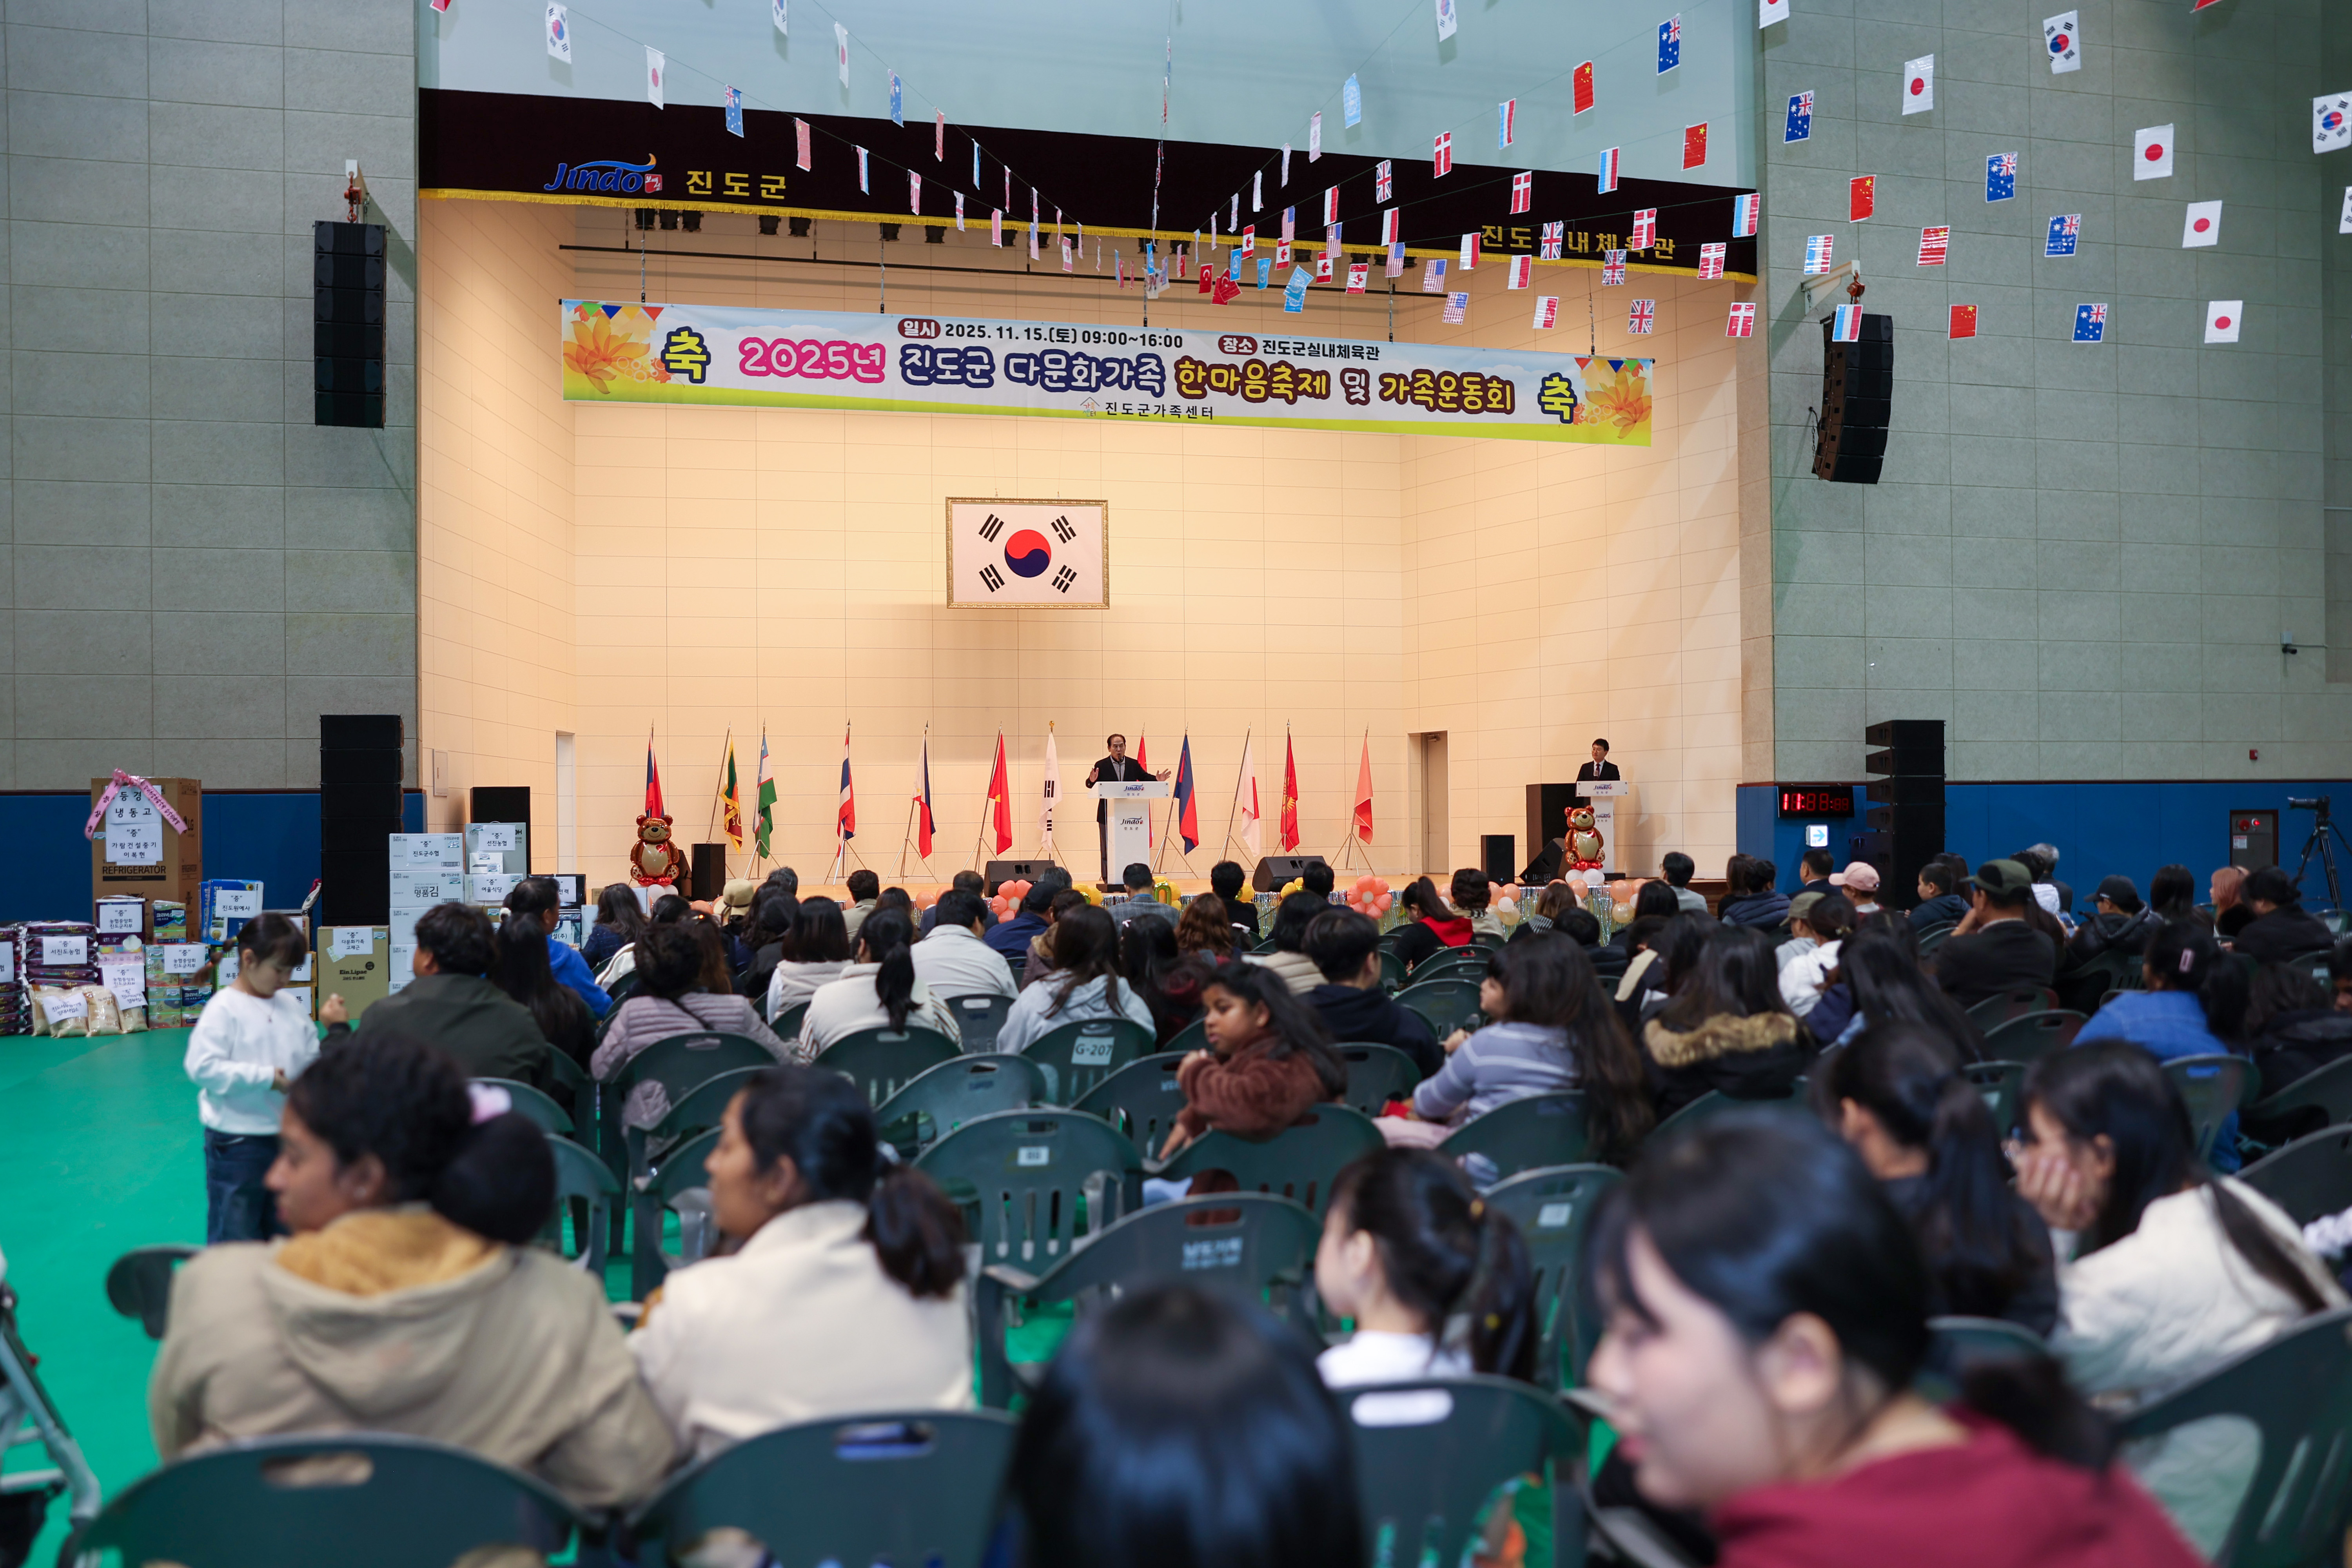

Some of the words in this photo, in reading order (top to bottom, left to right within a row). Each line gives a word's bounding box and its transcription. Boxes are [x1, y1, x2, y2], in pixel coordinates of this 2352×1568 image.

[544, 163, 643, 192] Jindo
[686, 171, 786, 199] 진도군
[1481, 225, 1675, 260] 진도내체관
[903, 321, 936, 337] 일시
[945, 324, 991, 339] 2025.
[996, 326, 1018, 340] 11.
[1082, 330, 1183, 348] 09:00~16:00
[1223, 338, 1254, 353] 장소
[1263, 339, 1379, 361] 진도군실내체육관
[662, 328, 710, 382] 축
[740, 339, 884, 381] 2025년
[902, 345, 993, 387] 진도군
[1006, 350, 1164, 395] 다문화가족
[1176, 359, 1329, 402] 한마음축제
[1342, 369, 1371, 403] 및
[1381, 371, 1515, 413] 가족운동회
[1539, 375, 1577, 422] 축
[1105, 402, 1213, 419] 진도군가족센터
[116, 808, 152, 817] 냉동고
[1076, 1044, 1113, 1056] G-207
